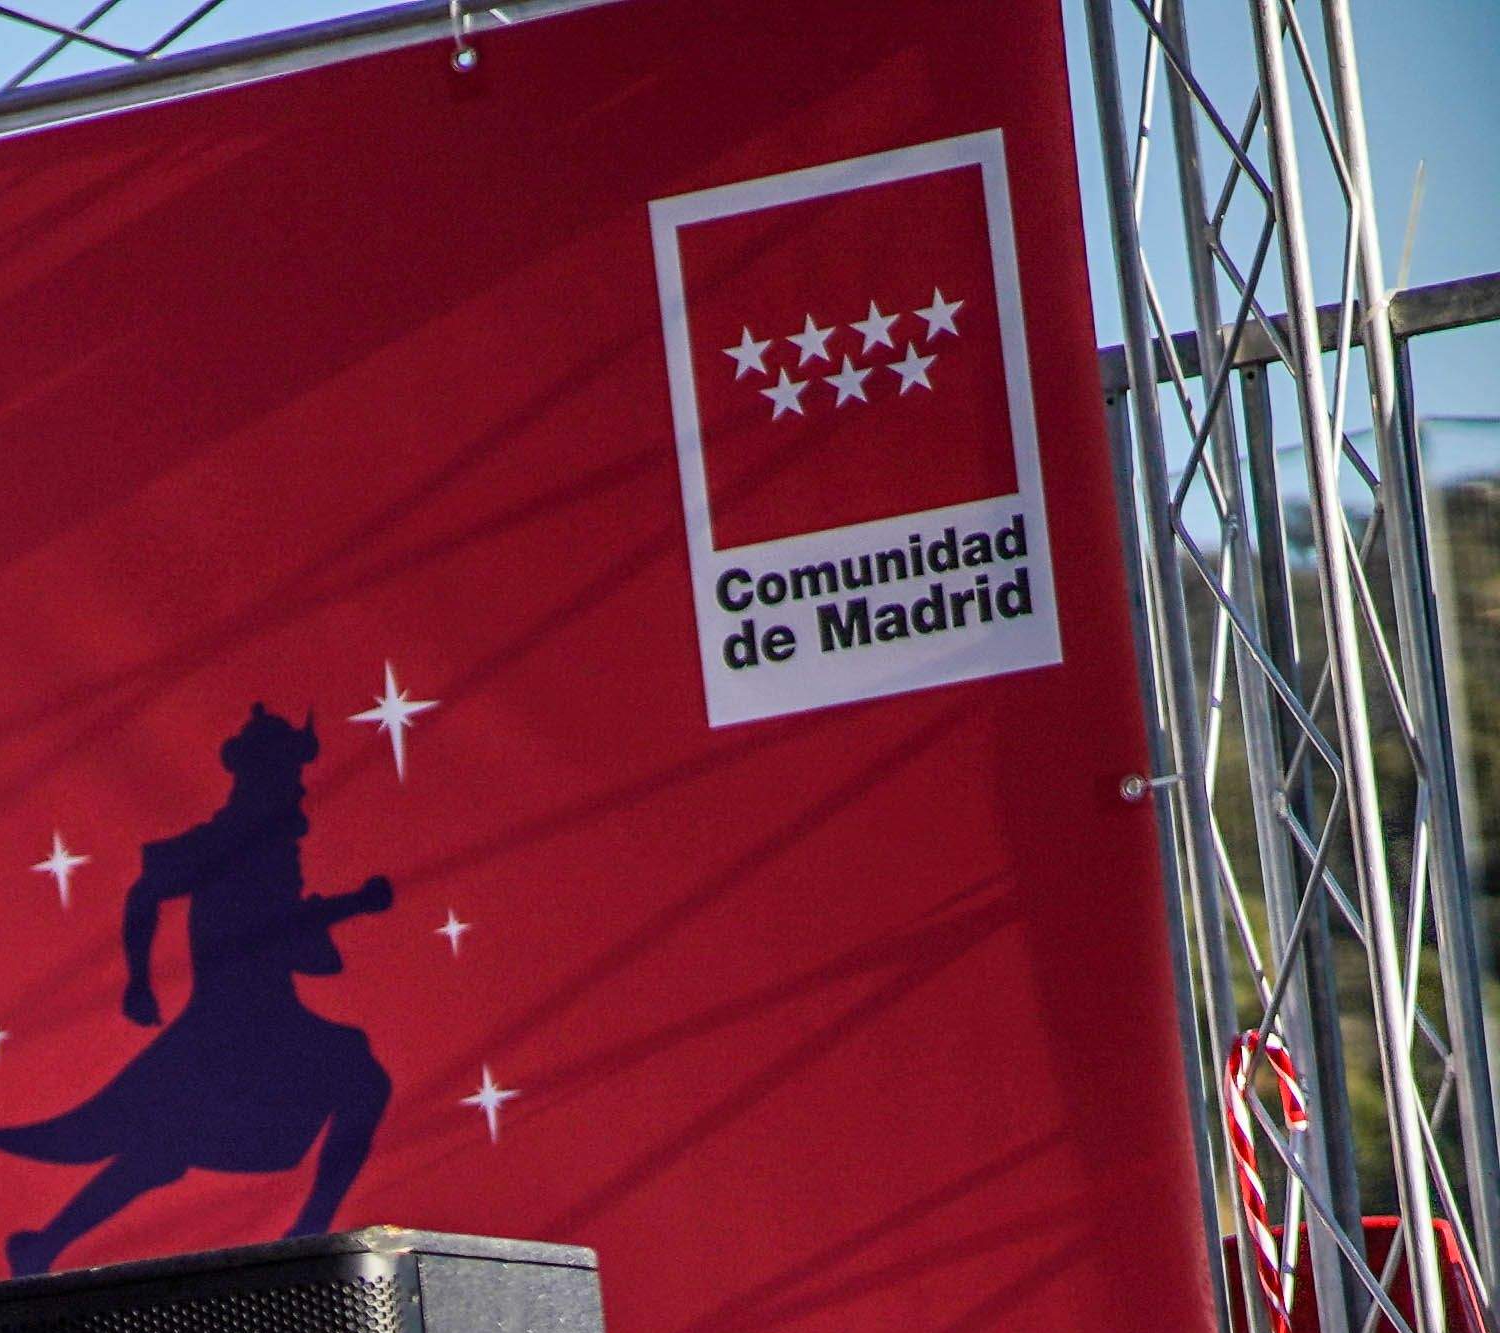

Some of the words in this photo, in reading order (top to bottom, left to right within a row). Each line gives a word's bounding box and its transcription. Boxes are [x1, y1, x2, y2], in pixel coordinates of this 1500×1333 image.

[715, 513, 1028, 612] Comunidad
[722, 619, 797, 671] de
[815, 566, 1034, 653] Madrid
